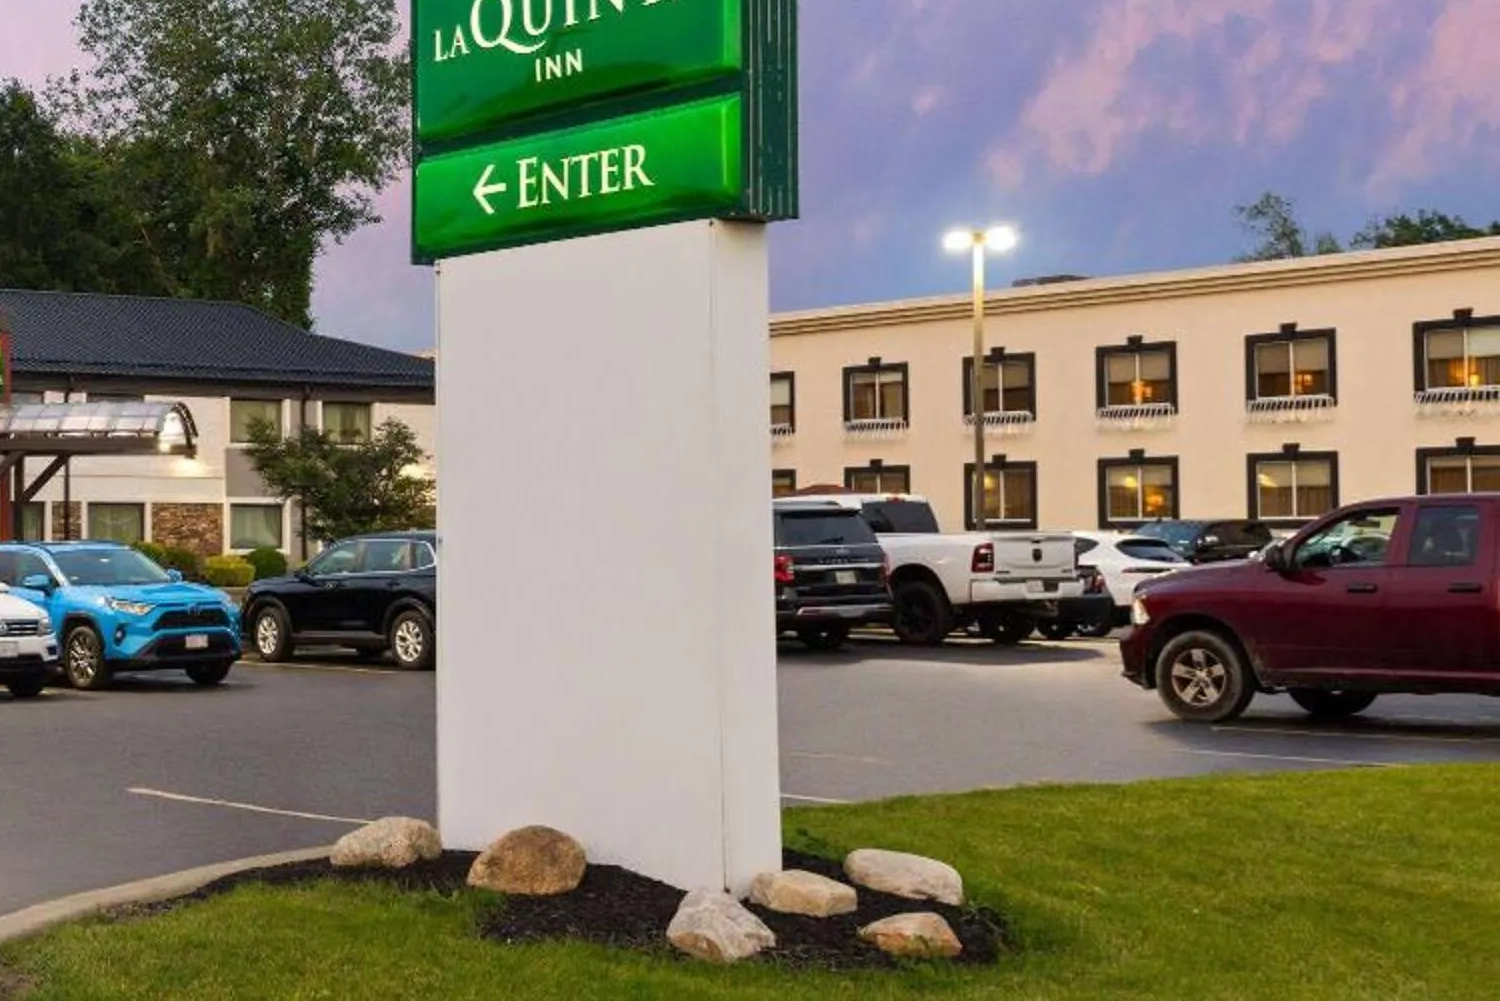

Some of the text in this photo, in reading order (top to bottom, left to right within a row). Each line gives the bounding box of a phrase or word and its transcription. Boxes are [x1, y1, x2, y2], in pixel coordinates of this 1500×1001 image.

[433, 24, 470, 62] LA
[535, 49, 582, 82] INN
[516, 144, 655, 208] ENTER
